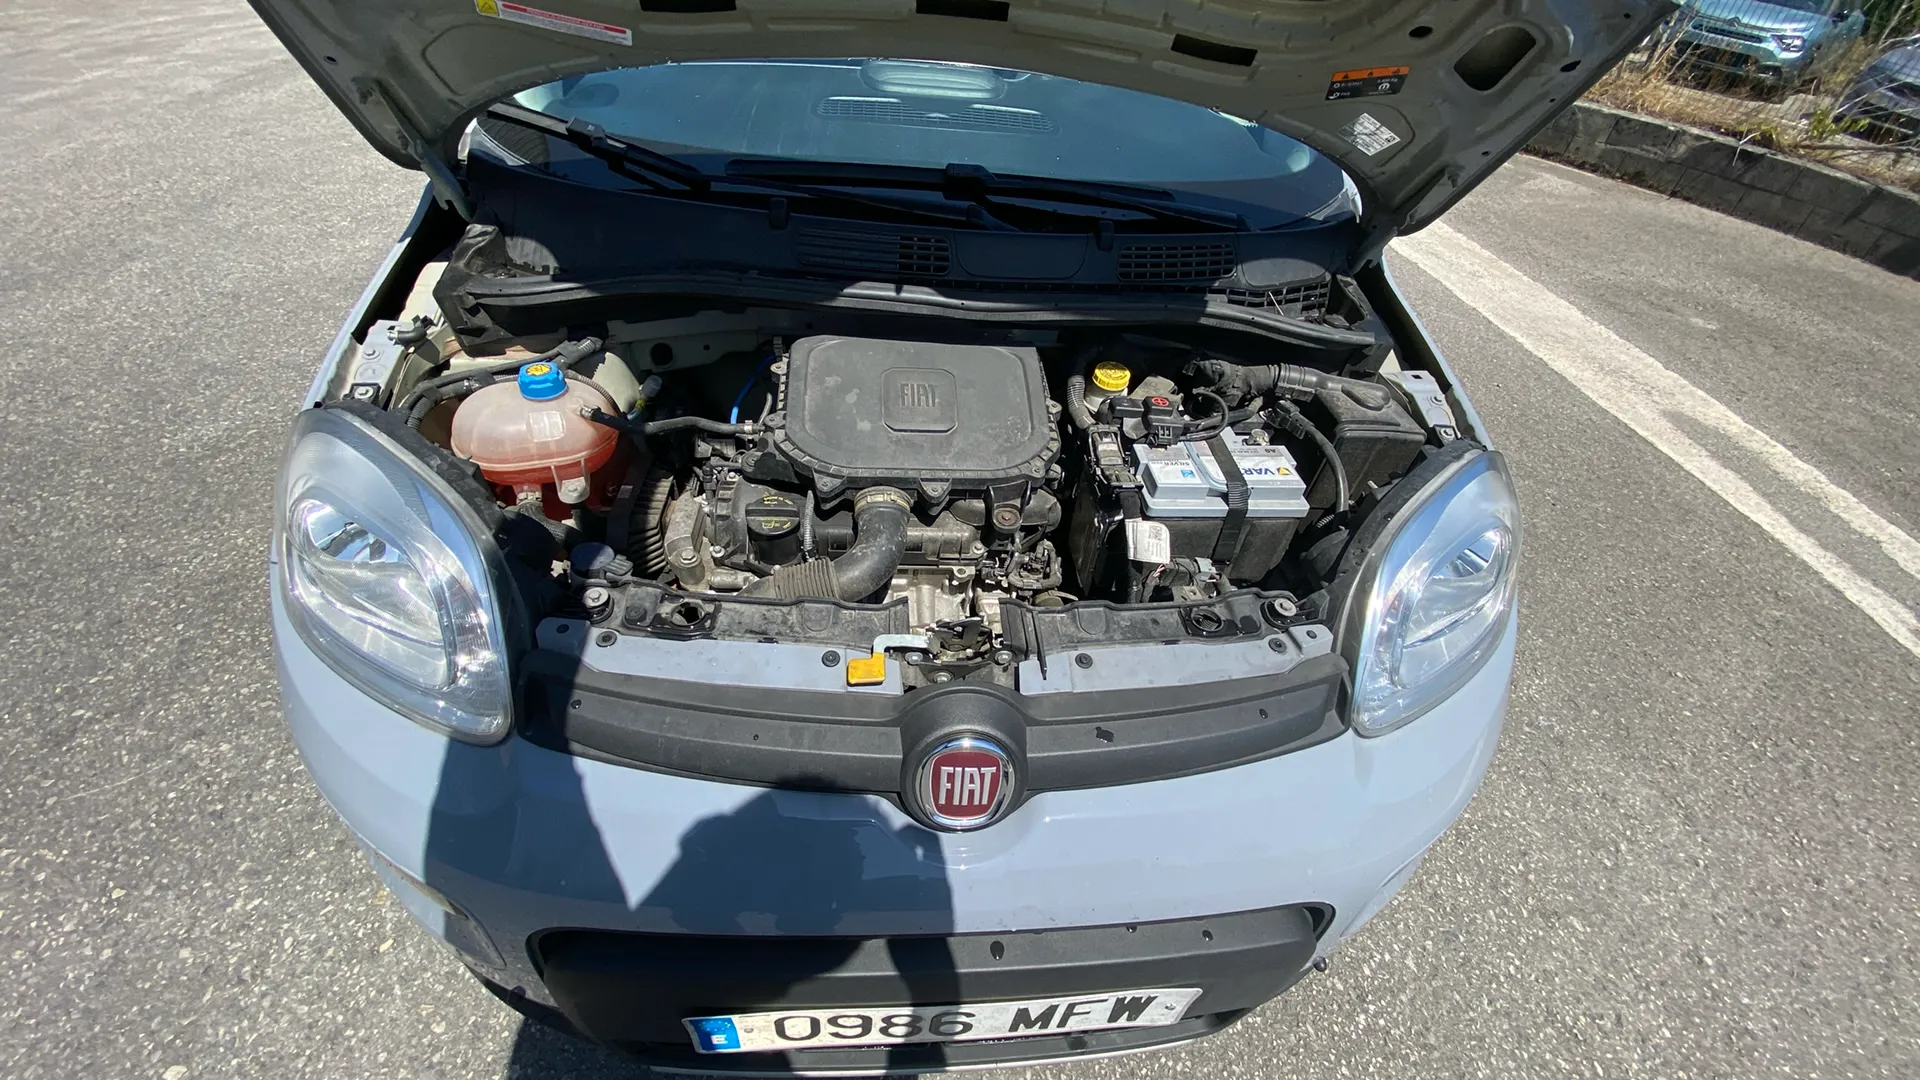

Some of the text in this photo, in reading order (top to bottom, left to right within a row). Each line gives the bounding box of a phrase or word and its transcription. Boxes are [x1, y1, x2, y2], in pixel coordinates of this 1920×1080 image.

[900, 383, 938, 408] FIAT
[1241, 467, 1276, 477] VAR
[938, 766, 997, 806] FIAT
[774, 995, 1159, 1042] 0986 MFW
[710, 1034, 729, 1045] E
